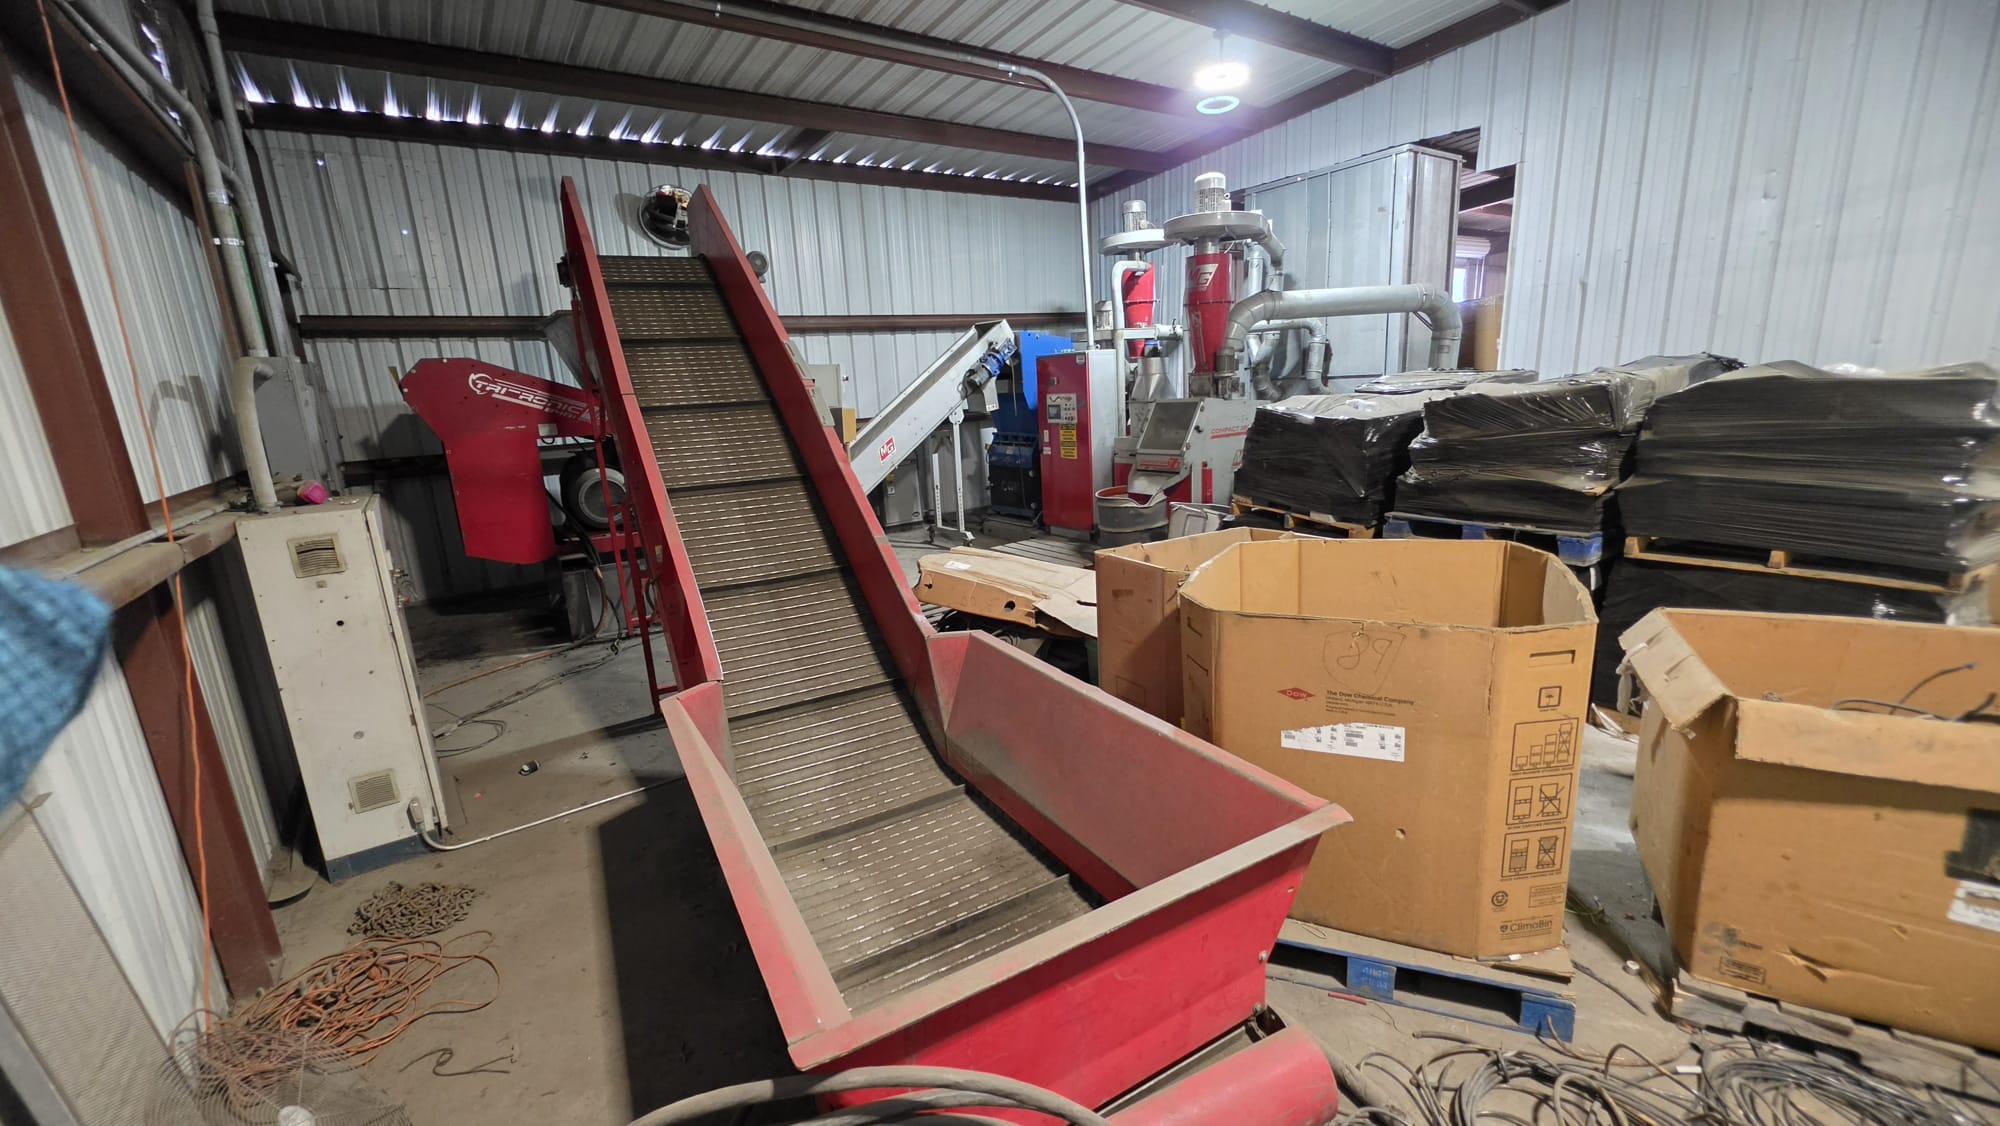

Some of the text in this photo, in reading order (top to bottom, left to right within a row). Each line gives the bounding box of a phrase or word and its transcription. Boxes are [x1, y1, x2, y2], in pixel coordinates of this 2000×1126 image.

[1286, 689, 1308, 698] DOW
[1326, 689, 1338, 697] The
[1353, 692, 1383, 702] Chemical
[1383, 696, 1415, 706] Company
[1509, 919, 1553, 932] ClimaBin
